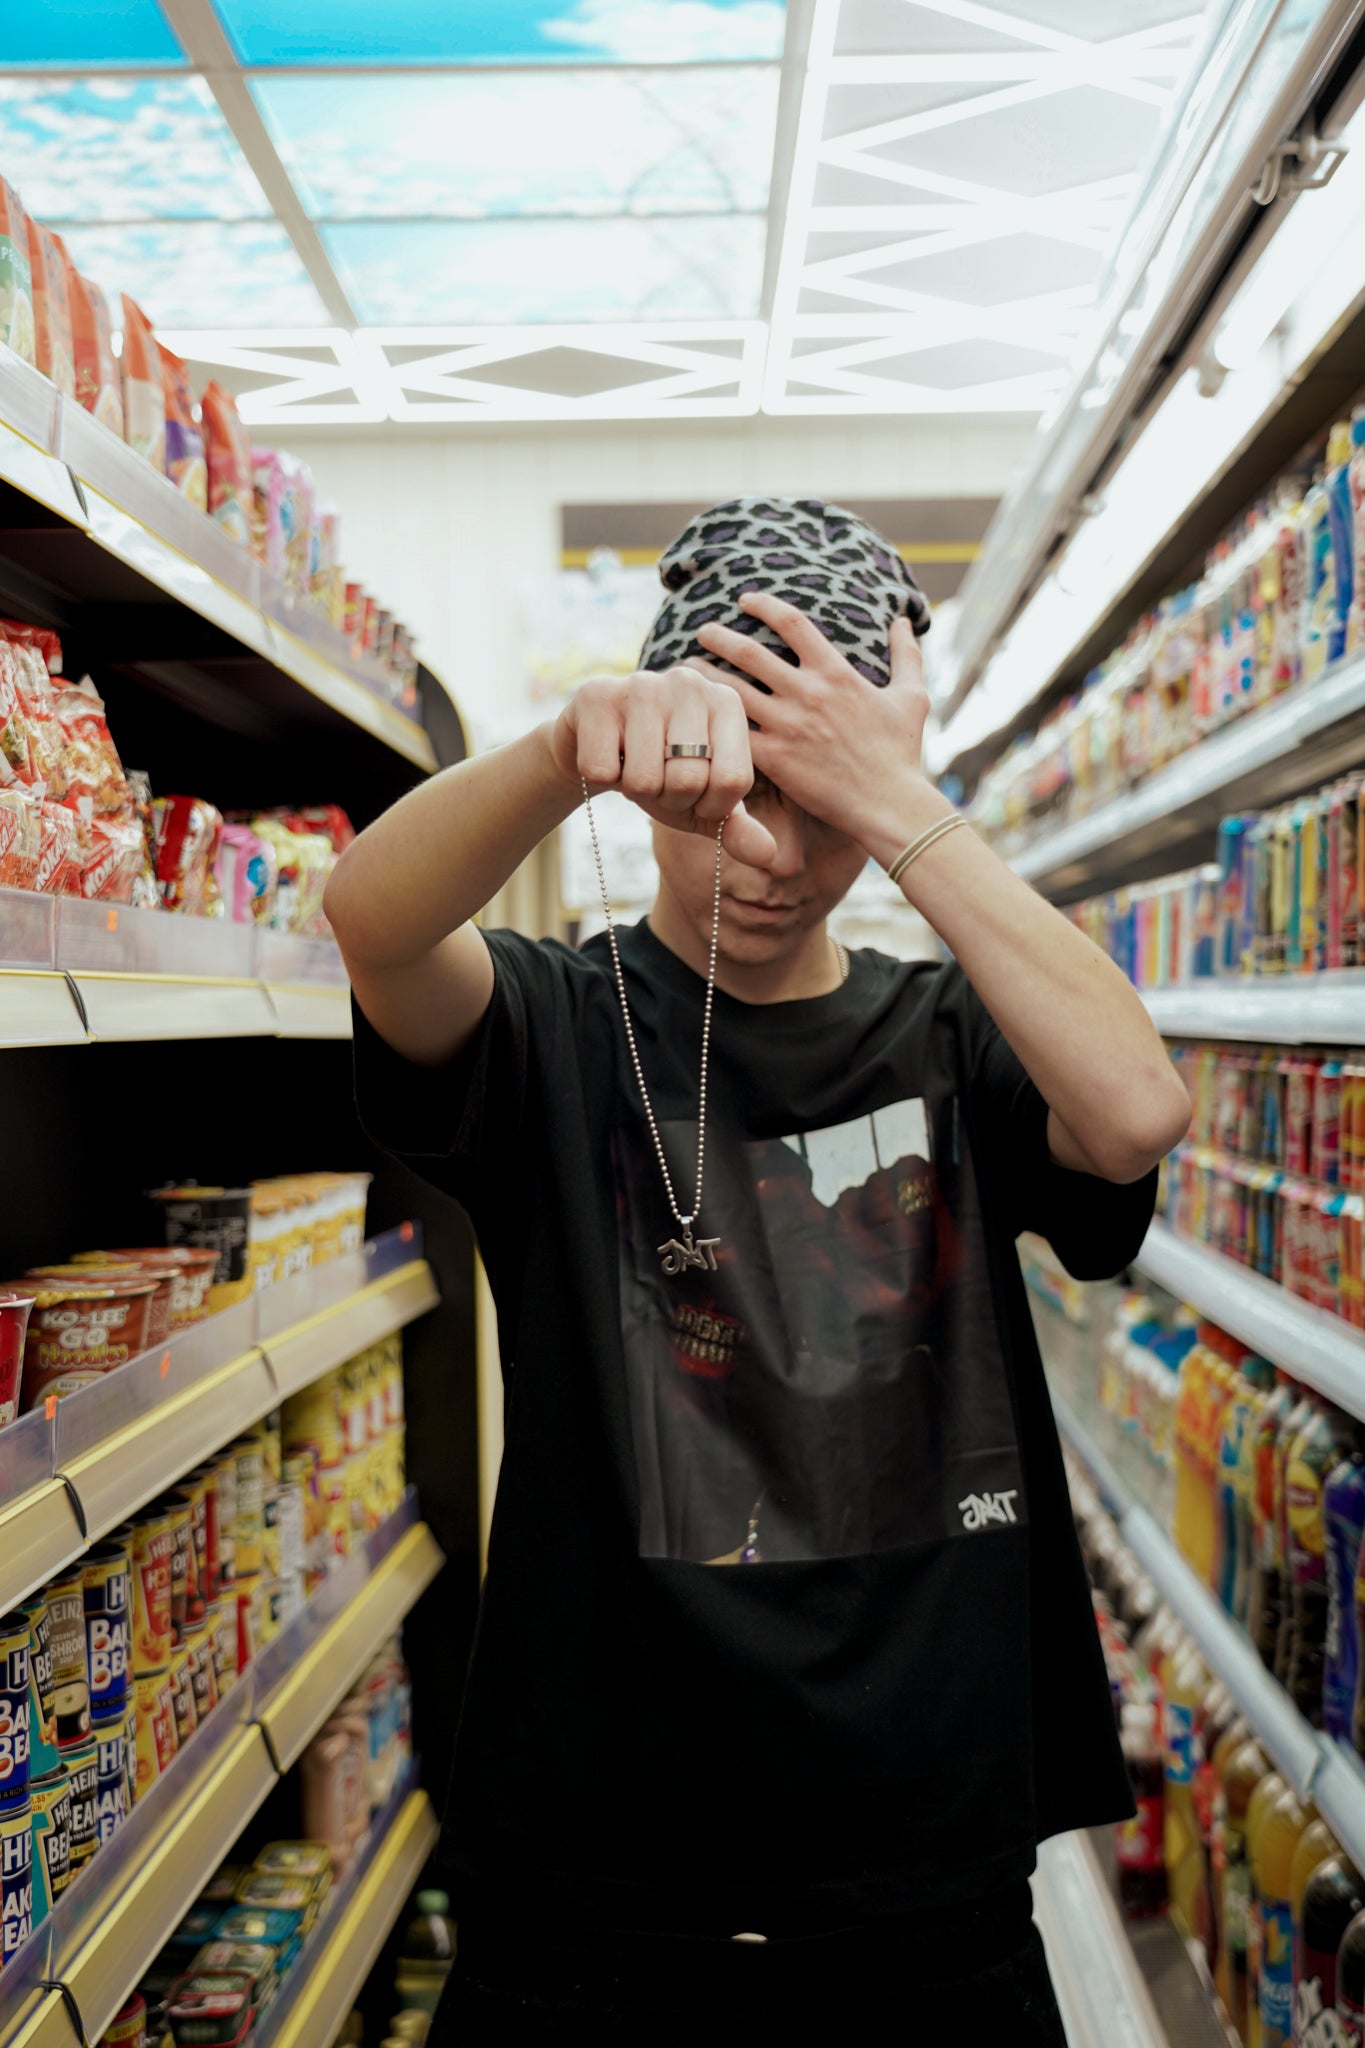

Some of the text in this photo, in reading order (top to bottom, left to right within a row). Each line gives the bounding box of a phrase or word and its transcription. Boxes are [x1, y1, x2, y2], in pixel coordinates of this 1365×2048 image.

[41, 1304, 130, 1328] KO-LEE
[59, 1326, 109, 1349] GO
[39, 1343, 129, 1369] Noodles
